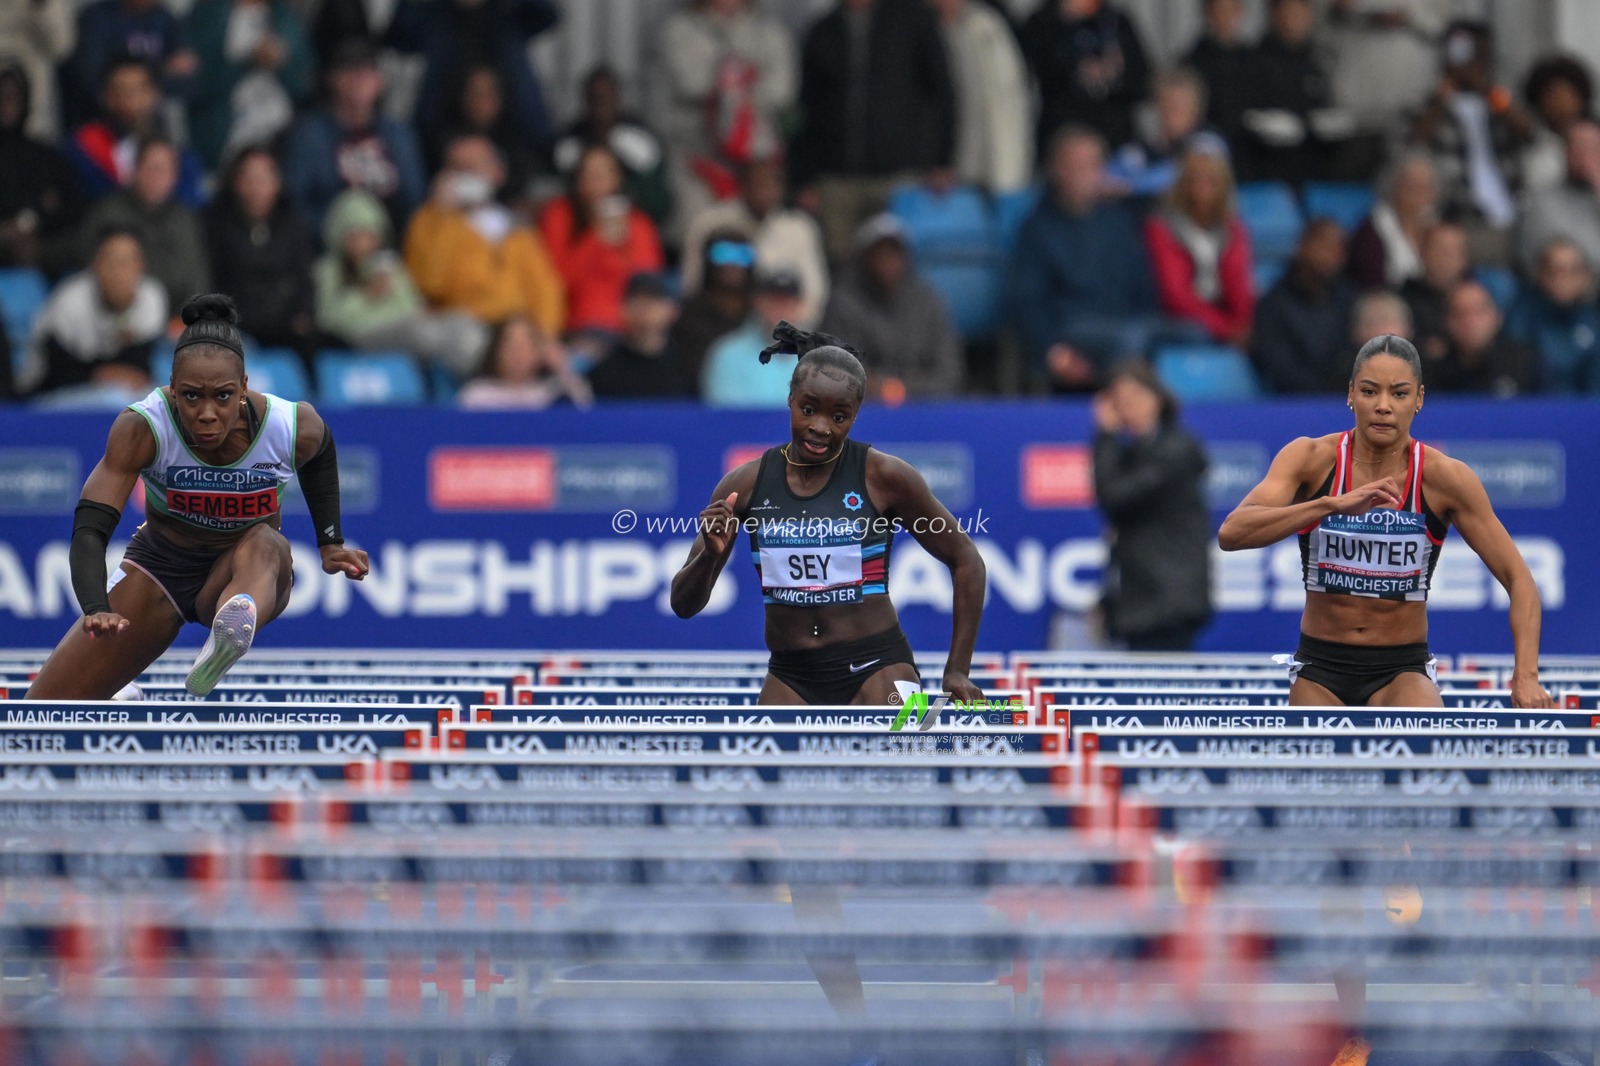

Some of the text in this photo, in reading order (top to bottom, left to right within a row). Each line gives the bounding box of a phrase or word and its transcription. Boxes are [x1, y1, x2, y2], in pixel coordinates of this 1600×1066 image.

[172, 493, 272, 517] SEMBER
[1346, 523, 1386, 531] PROCESSING
[1325, 535, 1419, 566] HUNTER
[788, 554, 831, 581] SEY
[1333, 565, 1366, 575] ATHLETICS
[1324, 572, 1413, 592] MANCHESTER
[772, 588, 856, 604] MANCHESTER
[7, 710, 129, 724] MANCHESTER
[219, 712, 341, 725] MANCHESTER
[584, 716, 707, 727] MANCHESTER
[1164, 716, 1286, 730] MANCHESTER
[1375, 717, 1498, 731] MANCHESTER
[83, 734, 144, 754] UKA
[162, 735, 300, 754] MANCHESTER
[316, 734, 378, 754] UKA
[487, 735, 549, 755] UKA
[565, 736, 703, 755] MANCHESTER
[719, 736, 782, 756] UKA
[1118, 739, 1181, 759] UKA
[1198, 739, 1336, 759] MANCHESTER
[1352, 739, 1414, 759] UKA
[1430, 739, 1570, 760] MANCHESTER
